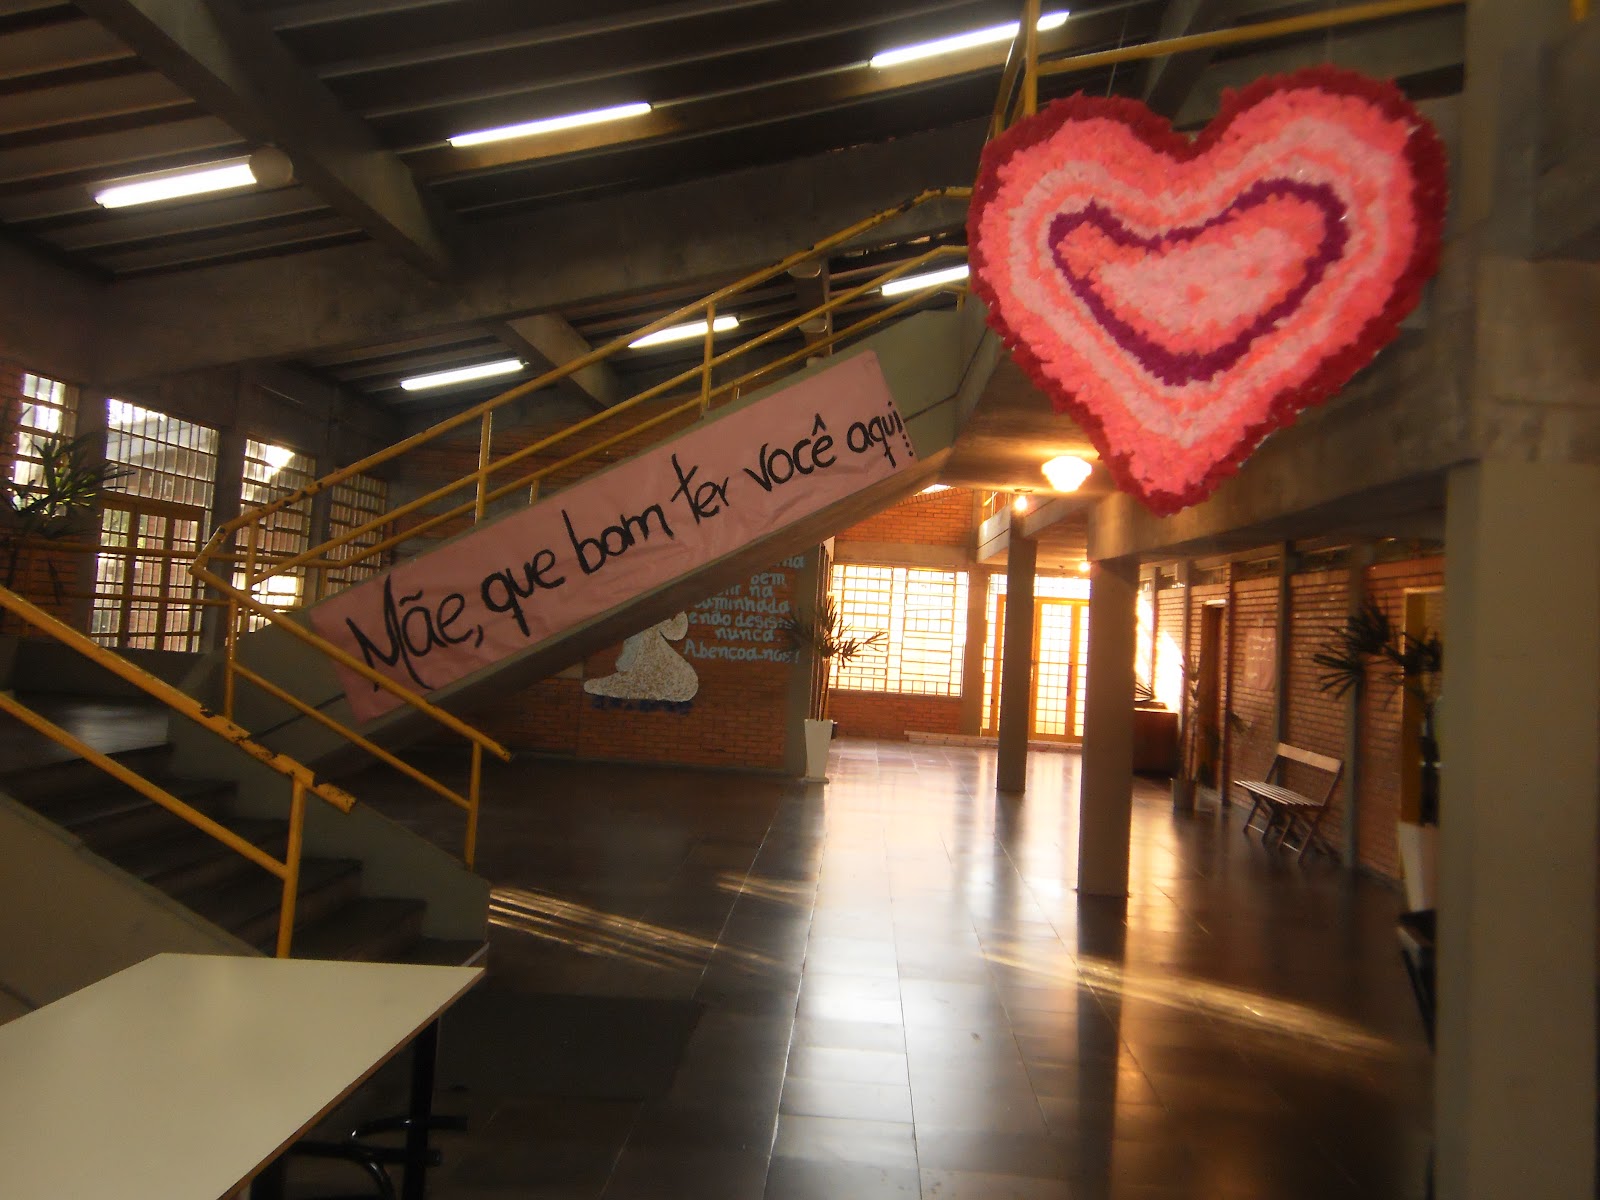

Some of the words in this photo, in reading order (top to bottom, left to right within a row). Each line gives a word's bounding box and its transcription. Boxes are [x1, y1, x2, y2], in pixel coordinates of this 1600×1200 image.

[346, 575, 484, 691] Mãe,
[481, 549, 566, 637] que
[562, 509, 675, 575] bom
[671, 453, 730, 524] ter
[743, 413, 837, 492] você
[749, 584, 775, 598] na
